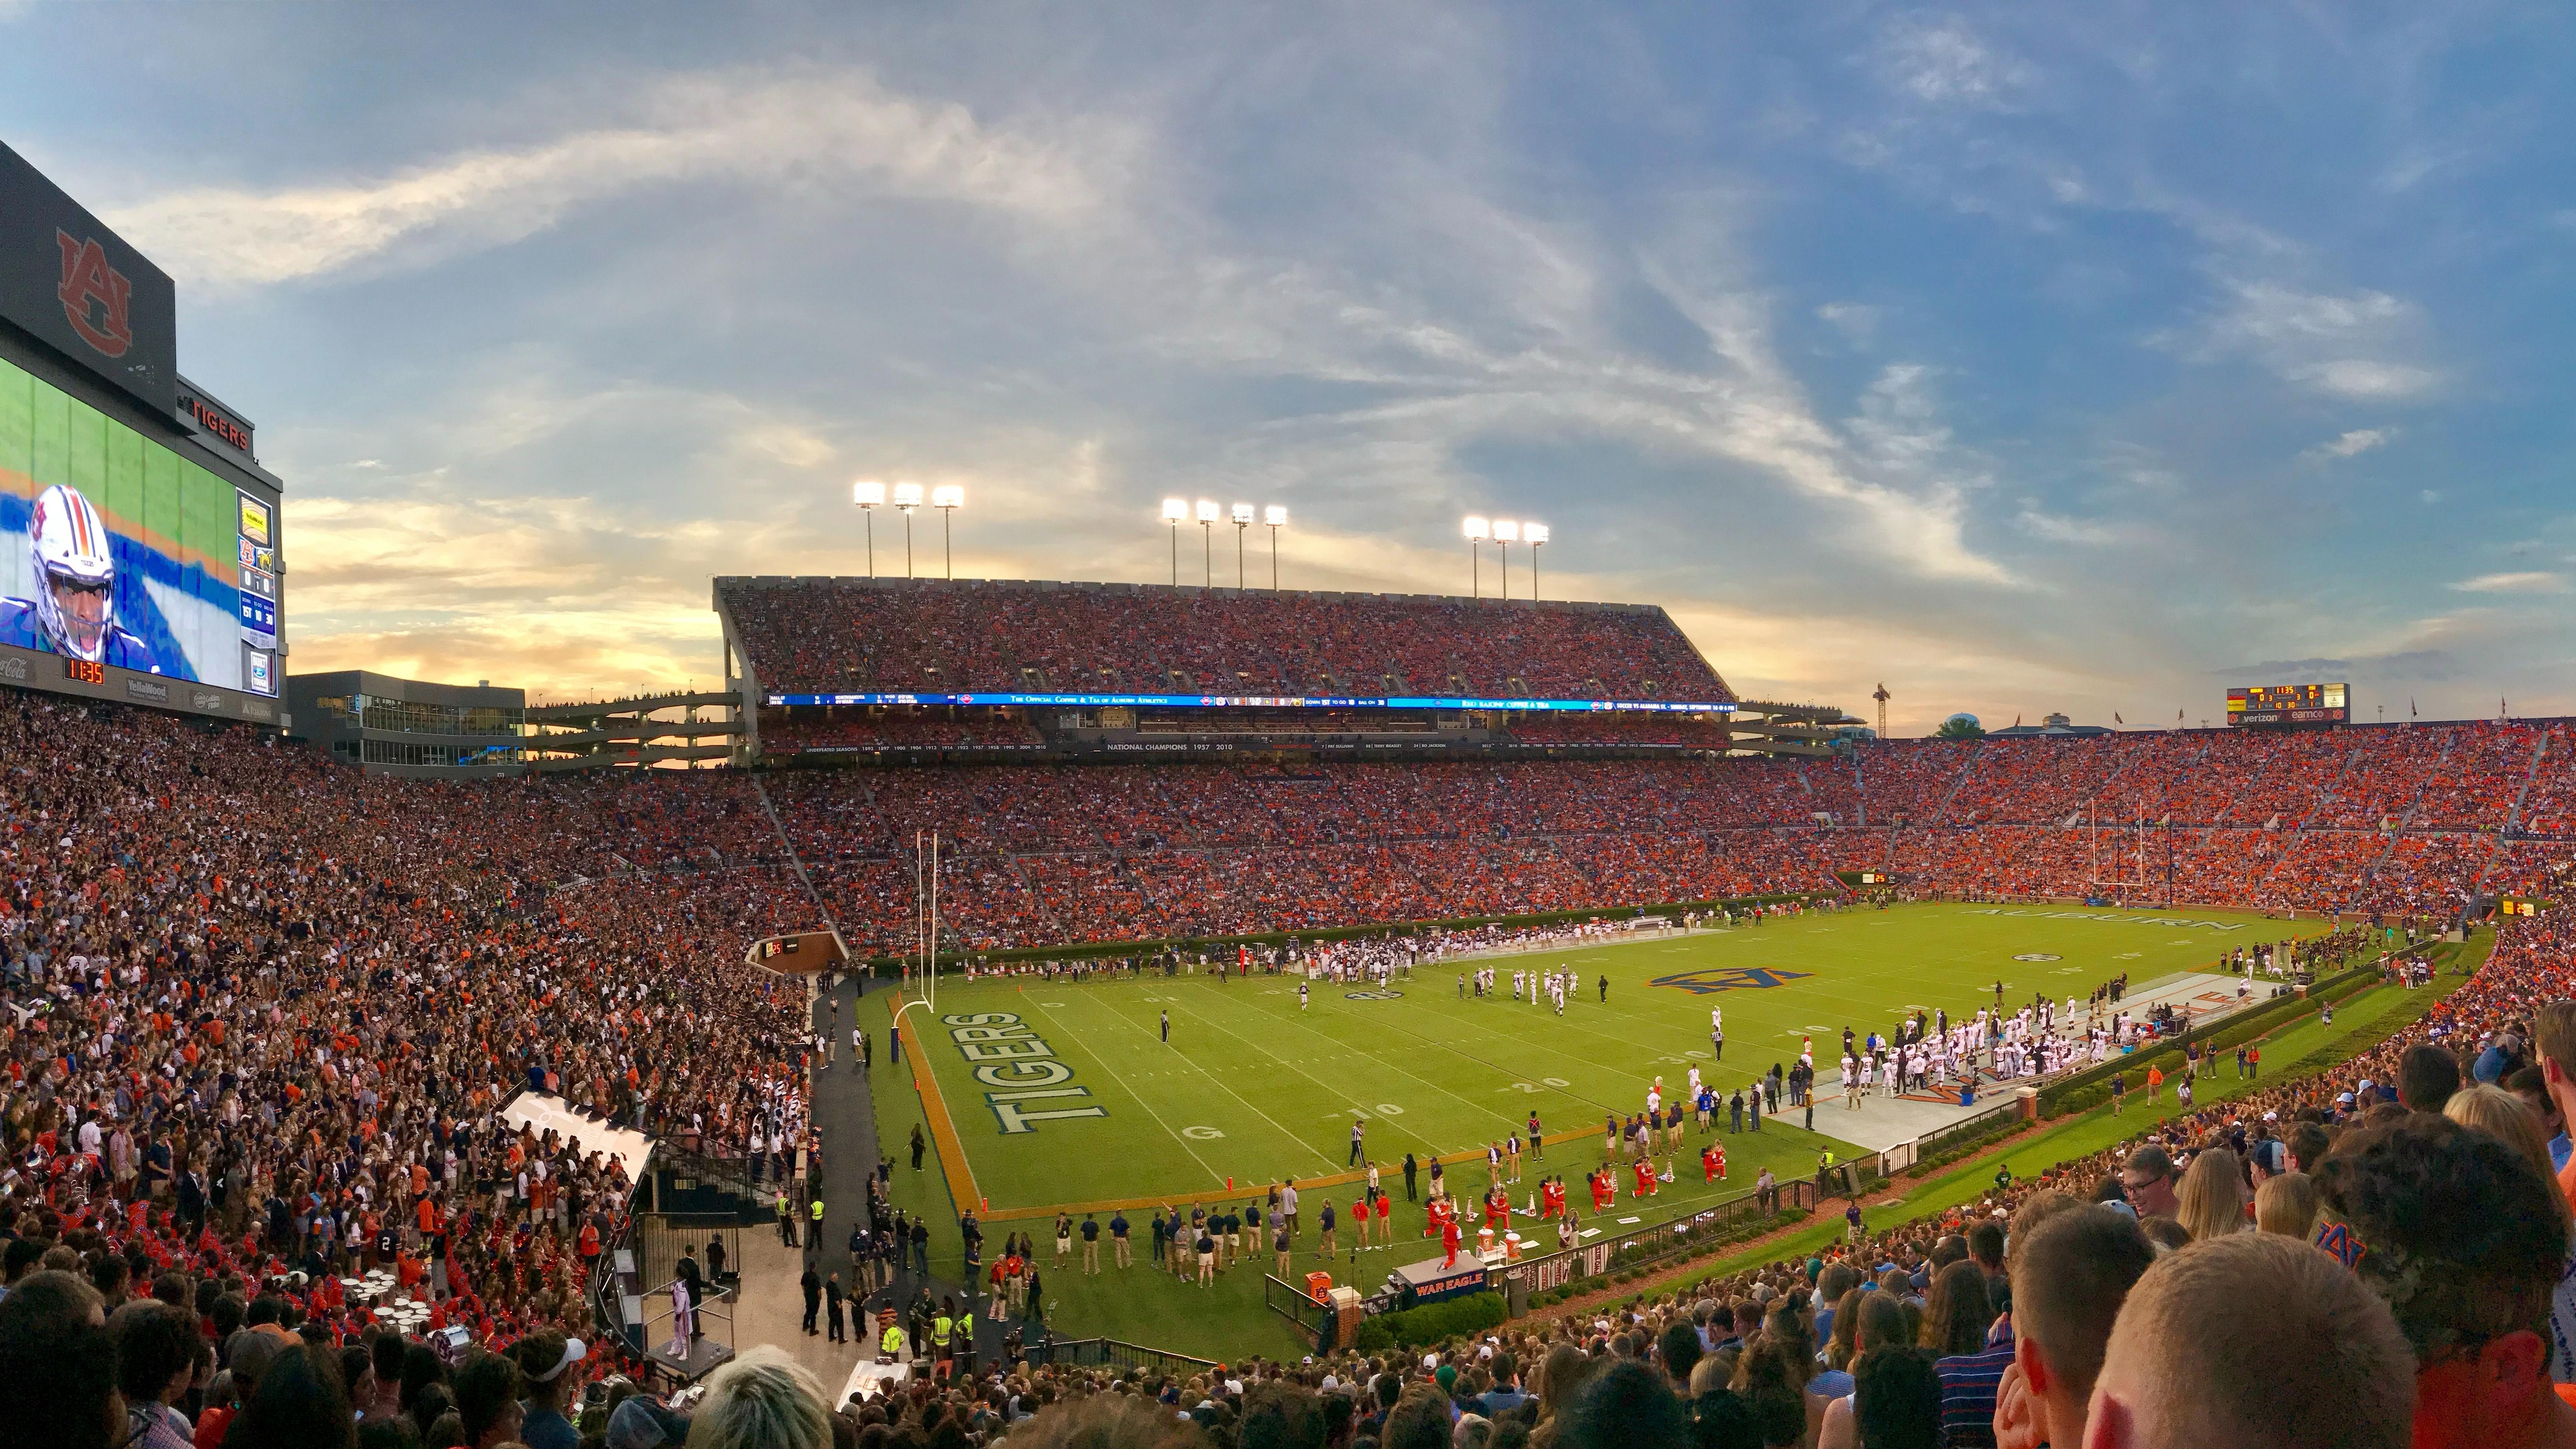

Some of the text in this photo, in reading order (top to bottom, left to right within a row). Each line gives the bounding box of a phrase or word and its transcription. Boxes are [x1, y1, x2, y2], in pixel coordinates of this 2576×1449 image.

[193, 400, 248, 451] TIGERS
[244, 570, 251, 586] 0
[256, 581, 260, 590] 1
[263, 578, 270, 593] 0
[242, 605, 252, 619] 1ST
[255, 610, 262, 622] 10
[266, 613, 273, 625] 30
[252, 656, 266, 669] BUILT
[70, 659, 103, 685] 11:35
[127, 678, 166, 696] YellaWood
[253, 677, 267, 688] TOUGH
[2259, 694, 2265, 702] 0
[250, 706, 271, 717] REGIONS
[2243, 713, 2278, 722] verizon
[2292, 710, 2317, 718] eamc
[1962, 908, 2253, 930] AUBURN
[773, 943, 781, 955] 25
[1885, 1004, 1931, 1015] 50
[1786, 1025, 1832, 1036] 40
[1661, 1050, 1713, 1065] 30
[1864, 1061, 1872, 1069] 67
[941, 1011, 1110, 1135] TIGERS
[1511, 1076, 1571, 1094] 20
[1346, 1103, 1405, 1121] 10
[1181, 1125, 1226, 1140] G
[382, 1236, 390, 1251] 2
[1416, 1273, 1484, 1297] WAR EAGLE
